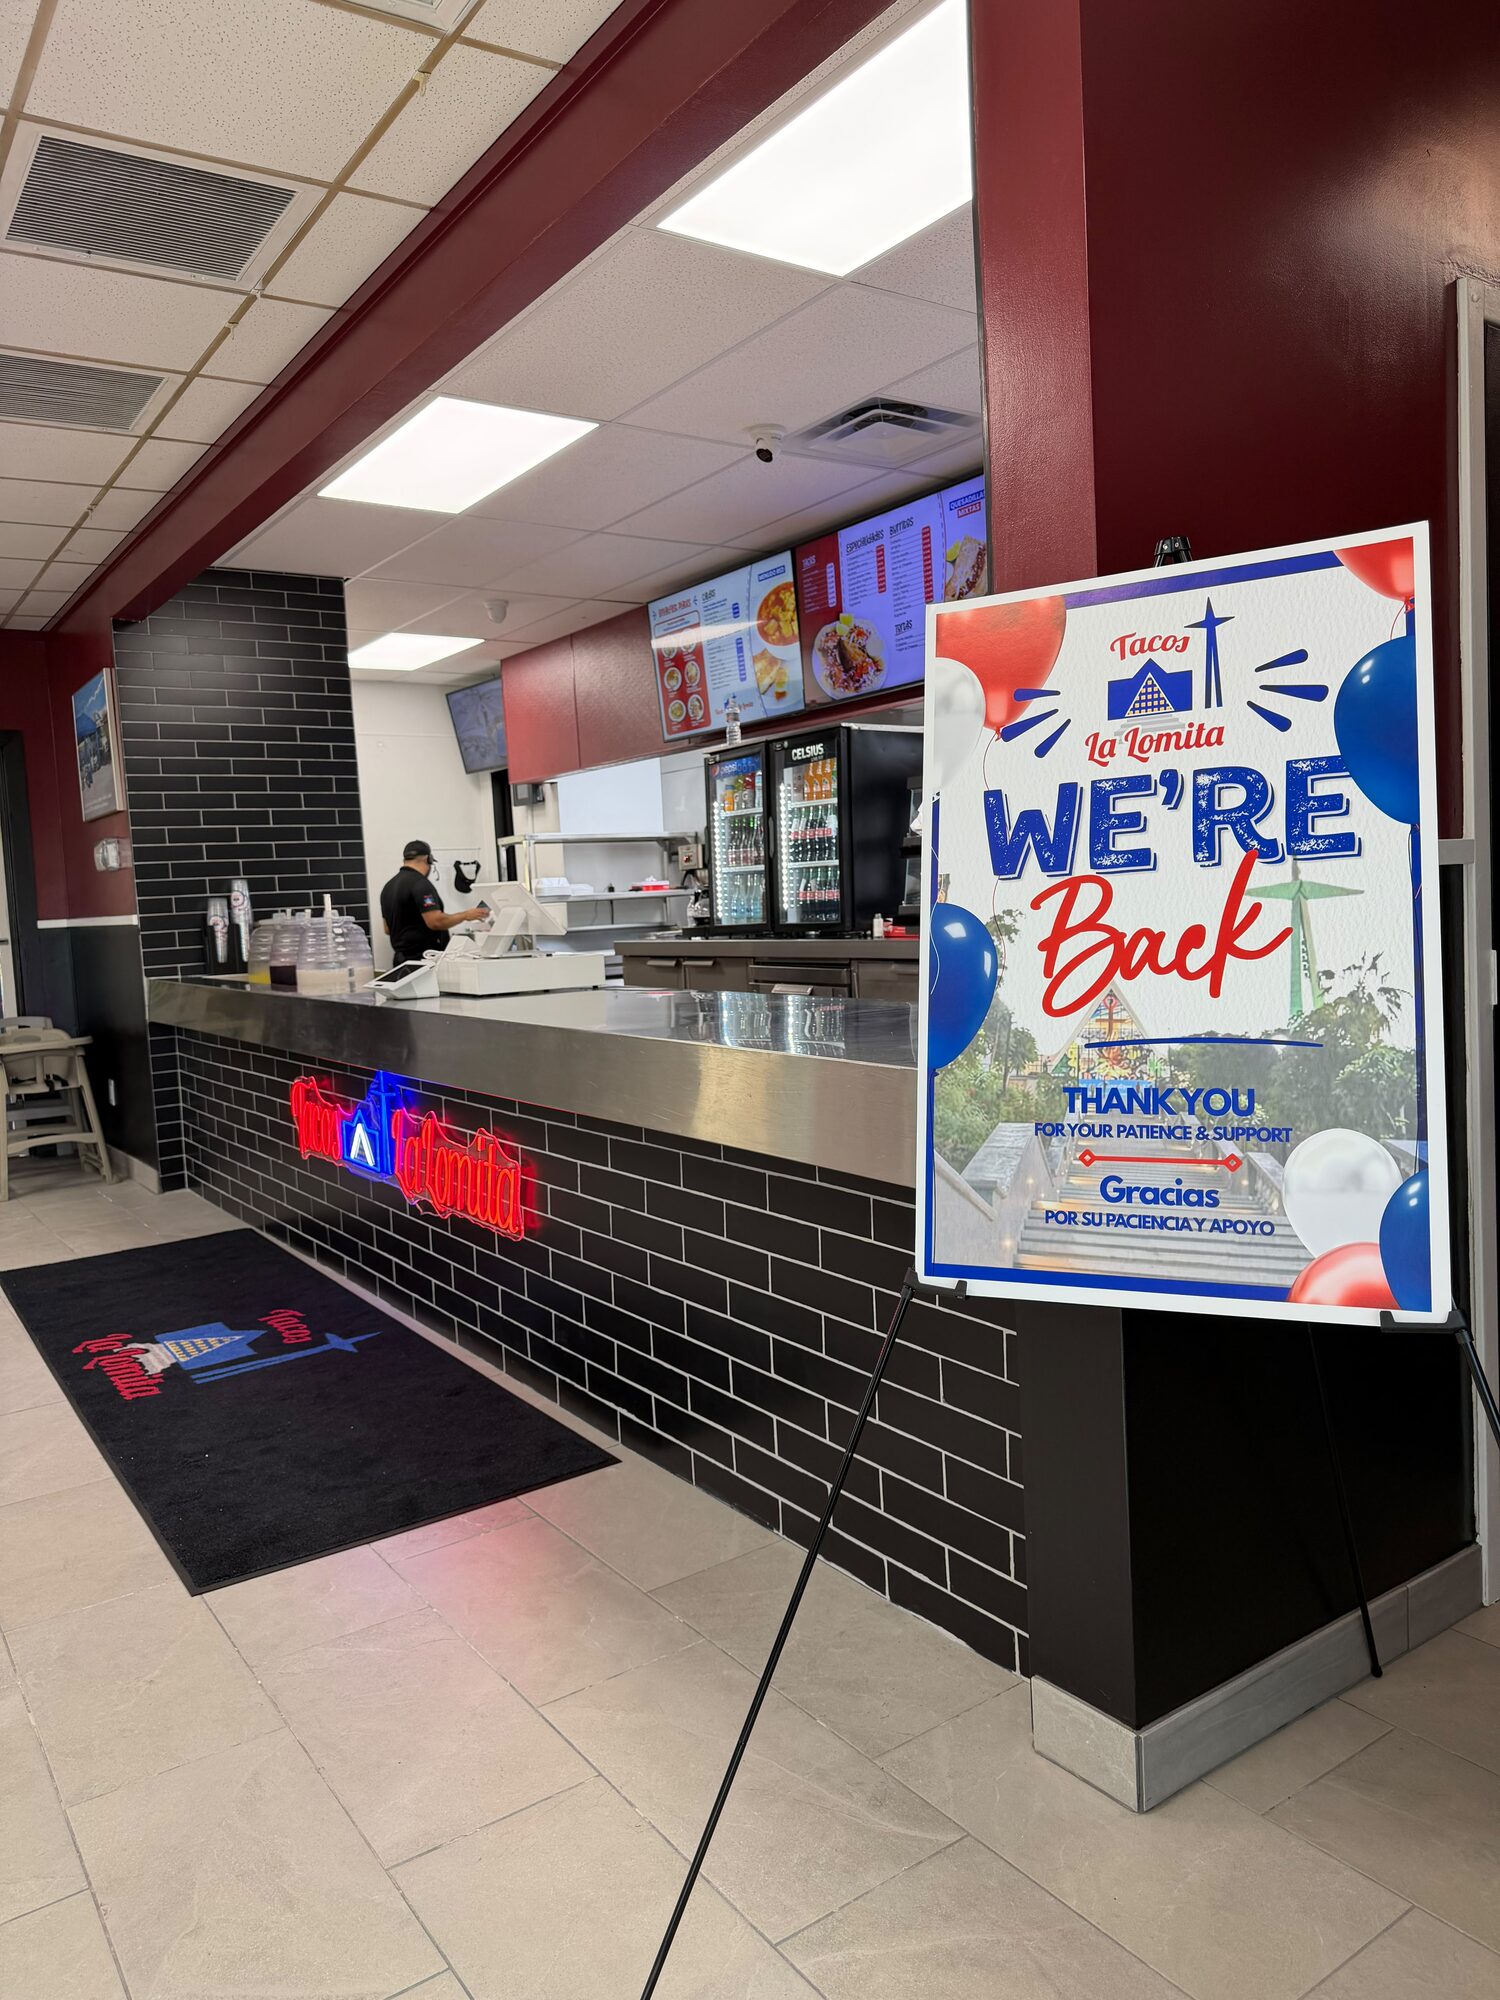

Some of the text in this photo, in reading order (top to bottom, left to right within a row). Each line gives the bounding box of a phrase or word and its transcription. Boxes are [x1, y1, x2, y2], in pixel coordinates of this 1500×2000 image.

[958, 503, 980, 517] MIXTAS
[1109, 631, 1190, 661] Tacos
[791, 743, 824, 761] CELSIUS
[1084, 721, 1225, 767] La Lomita
[1030, 847, 1293, 1018] Back
[1062, 1086, 1256, 1118] THANK YOU
[290, 1080, 342, 1161] Tacos
[1034, 1122, 1293, 1143] FOR YOUR PATIENCE & SUPPORT
[422, 1117, 519, 1233] Lomita
[1099, 1174, 1221, 1208] Gracias
[1044, 1210, 1276, 1236] POR SU PACIENCIA Y APOYO
[257, 1308, 313, 1345] Tacos
[72, 1332, 165, 1401] La Lomita
